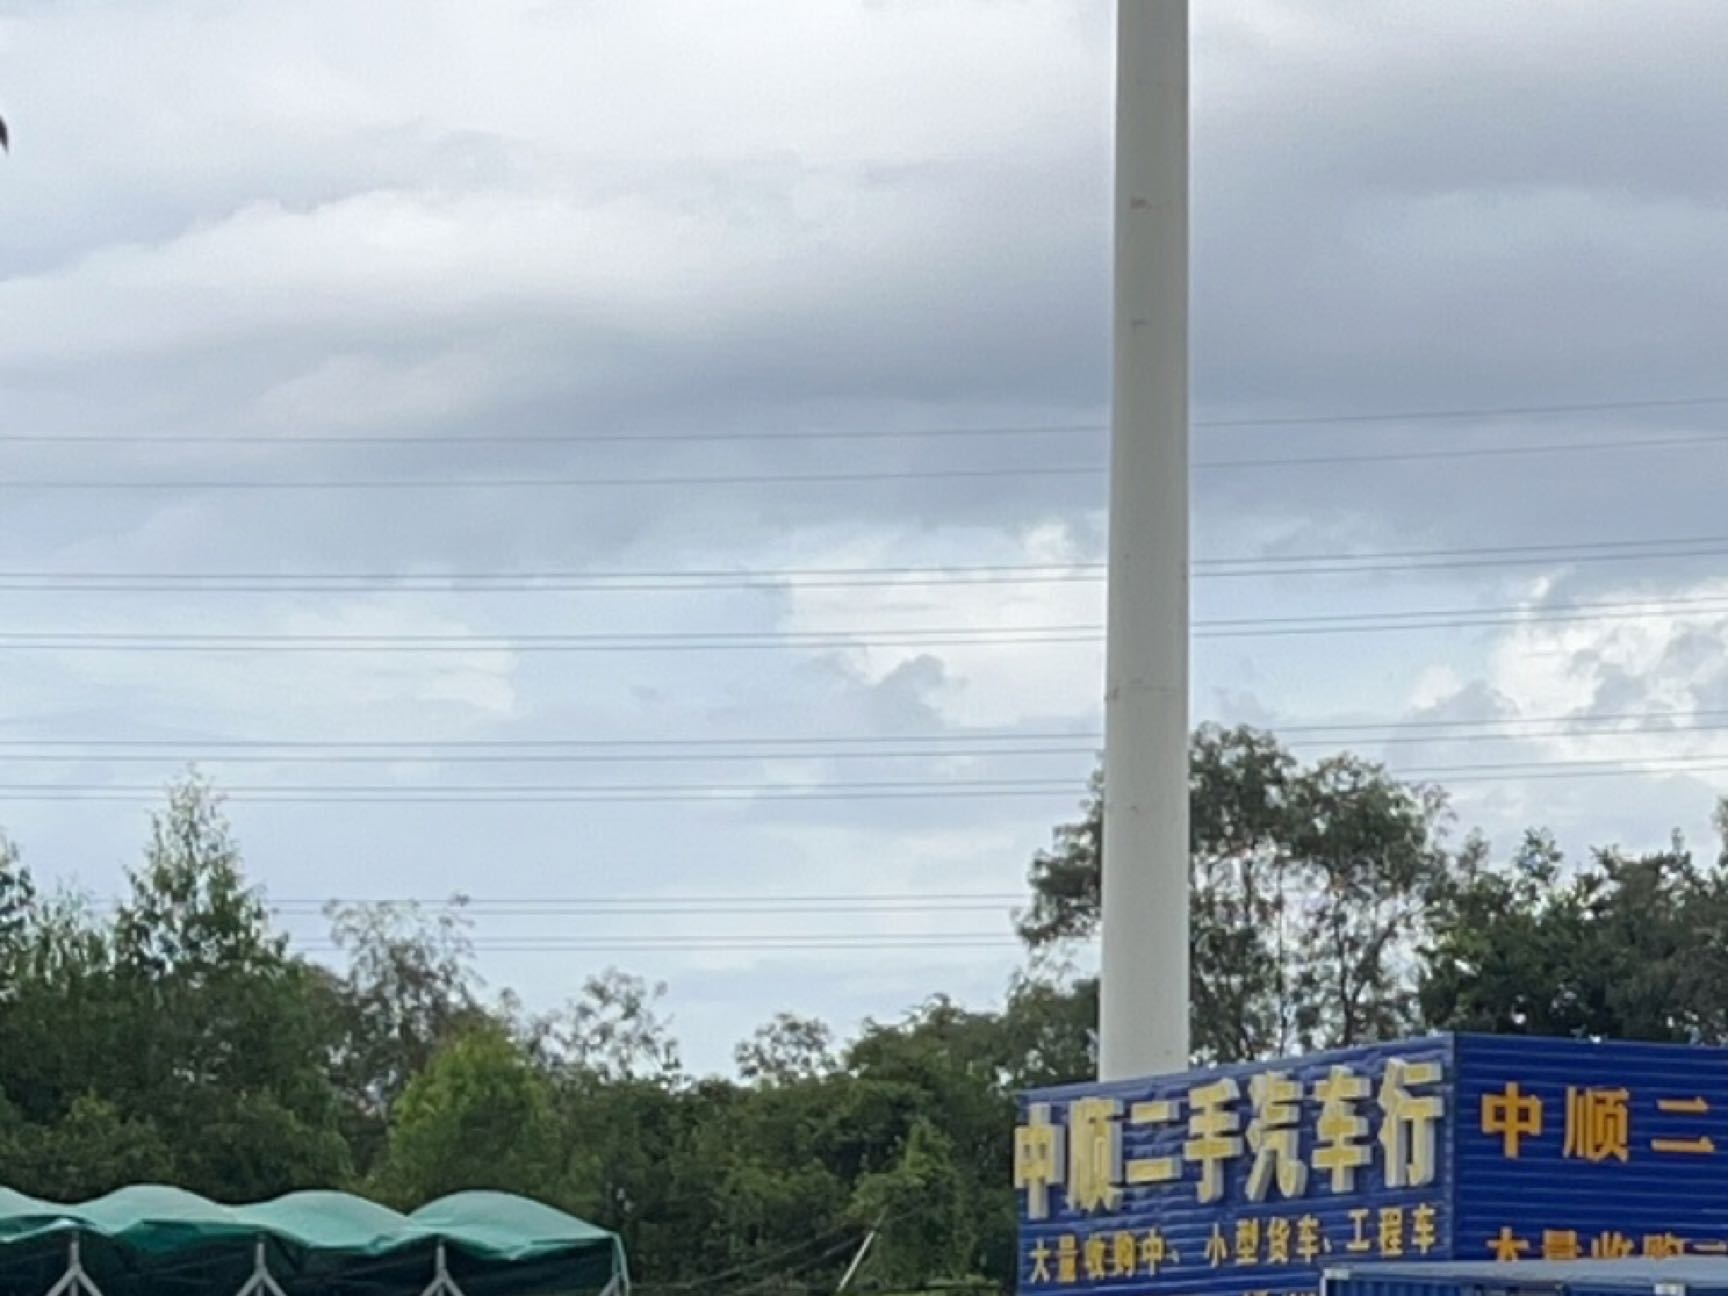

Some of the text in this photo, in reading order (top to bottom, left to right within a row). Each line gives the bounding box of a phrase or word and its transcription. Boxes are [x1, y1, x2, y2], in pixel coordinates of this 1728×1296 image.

[1014, 1057, 1444, 1219] 中顺二手汽车行
